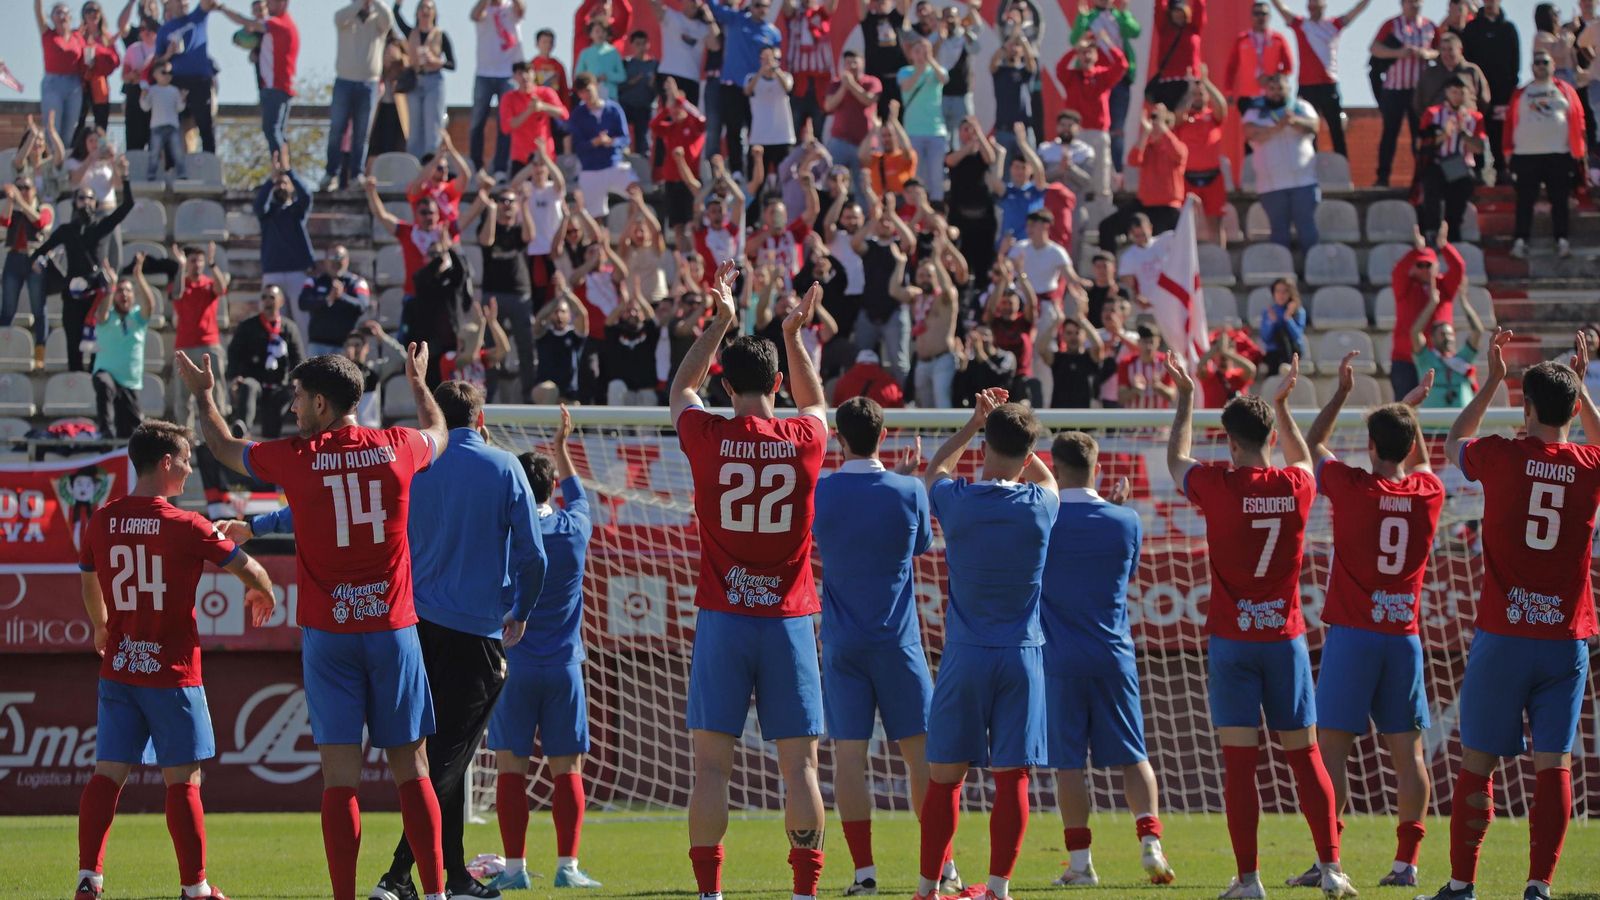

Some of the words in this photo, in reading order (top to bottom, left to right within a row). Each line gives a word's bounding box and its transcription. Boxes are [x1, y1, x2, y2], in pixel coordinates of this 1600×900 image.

[312, 453, 341, 471] JAVI
[346, 445, 397, 469] ALONSO
[720, 439, 756, 459] ALEIX
[760, 439, 797, 460] COCH
[323, 472, 387, 547] 14
[719, 462, 797, 533] 22
[1242, 496, 1296, 513] ESCUDERO
[120, 518, 161, 535] LARREA
[1525, 481, 1566, 551] 5
[1252, 518, 1281, 577] 7
[1377, 517, 1409, 575] 9
[110, 544, 167, 611] 24
[725, 565, 782, 593] Algeciras
[331, 580, 389, 604] Algeciras
[744, 588, 782, 608] Gusta
[353, 599, 389, 620] Gusta
[1526, 606, 1565, 625] Gusta
[128, 657, 161, 674] Gusta
